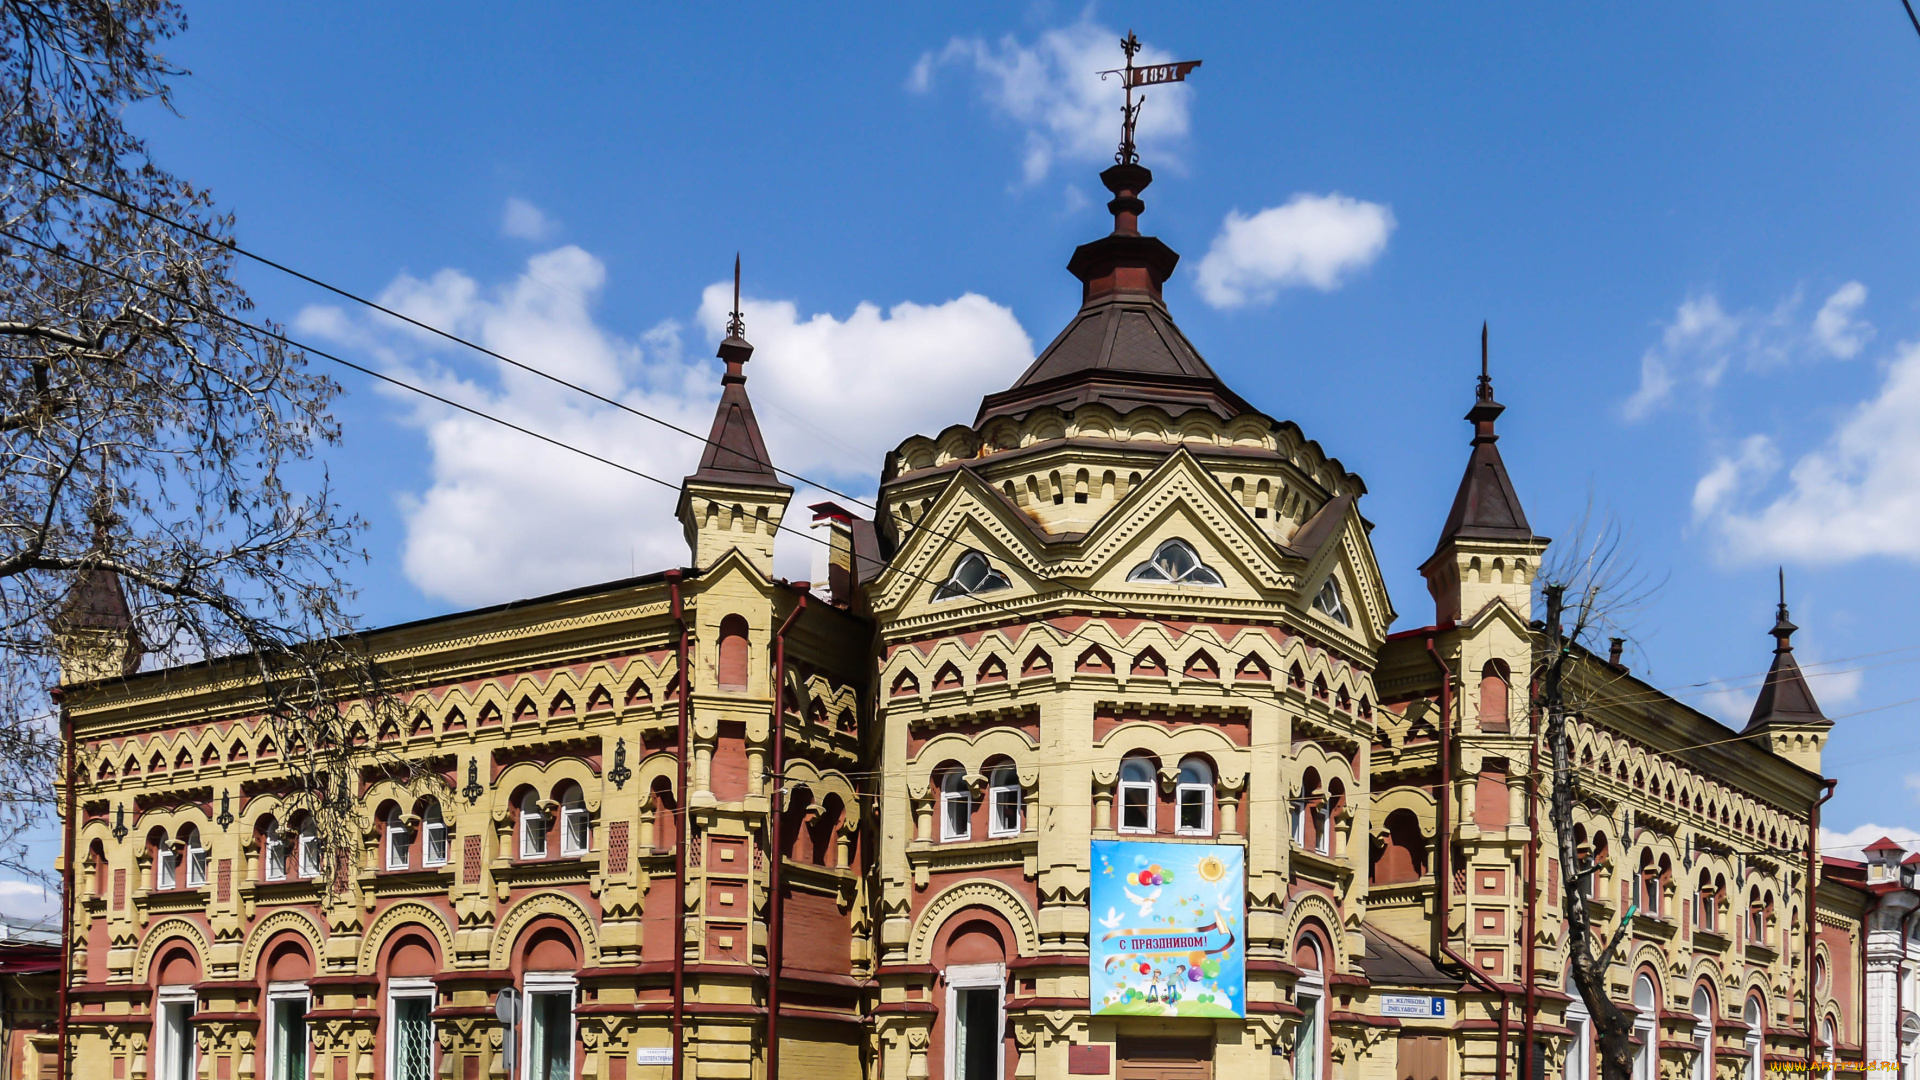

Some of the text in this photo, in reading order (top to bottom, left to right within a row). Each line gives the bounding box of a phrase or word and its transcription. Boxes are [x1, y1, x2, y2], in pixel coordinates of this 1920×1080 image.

[1140, 65, 1179, 83] 1897
[1119, 935, 1208, 950] С ПРАЗДНИКОМ!
[1435, 1001, 1442, 1012] 5
